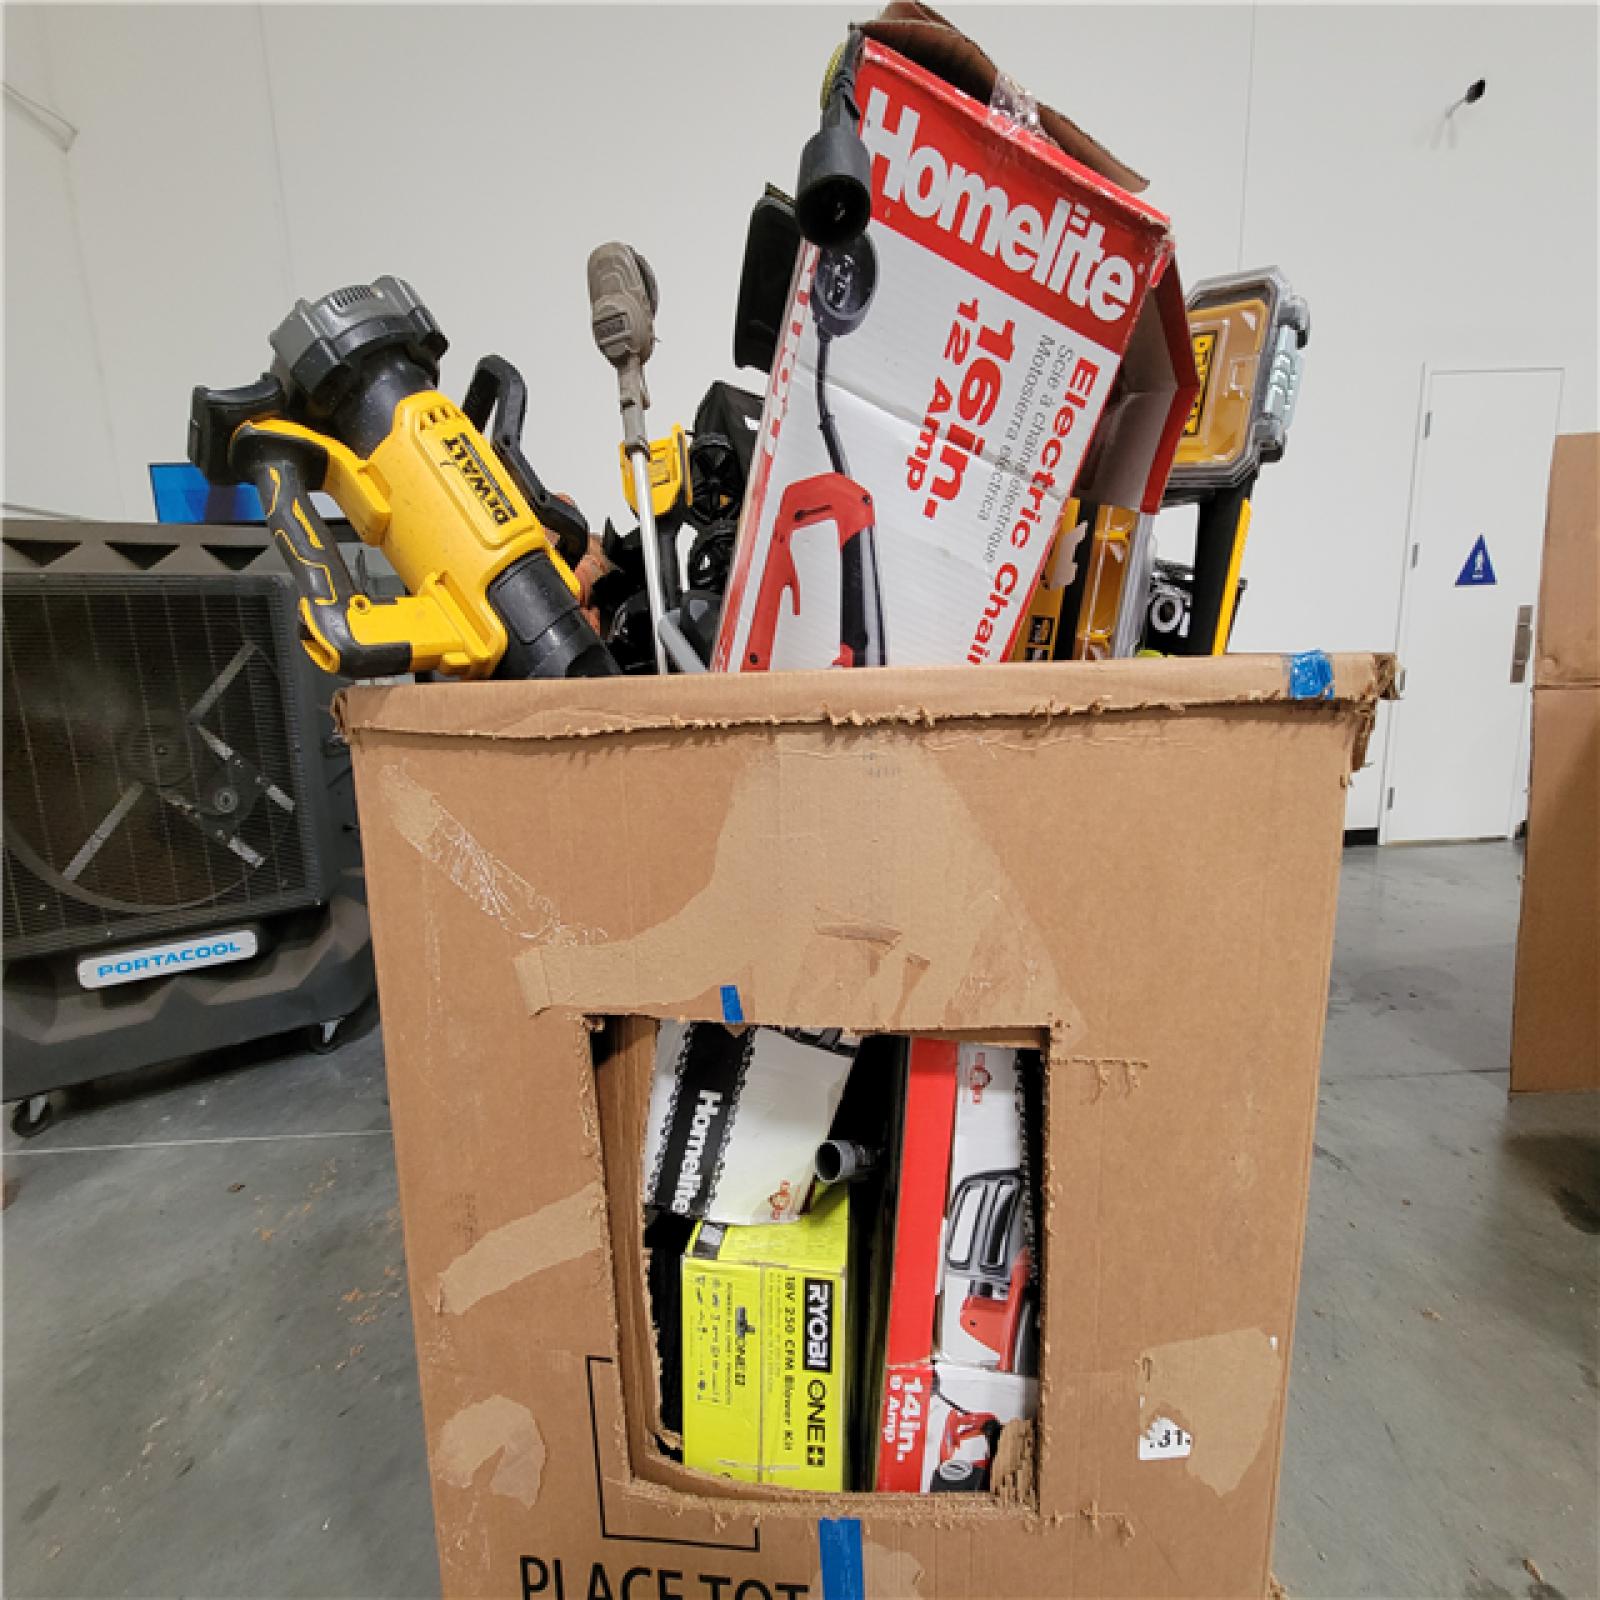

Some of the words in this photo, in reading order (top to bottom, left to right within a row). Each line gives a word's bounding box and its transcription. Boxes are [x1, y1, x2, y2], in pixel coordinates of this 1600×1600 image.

[860, 86, 1134, 321] Homelite
[942, 298, 979, 366] 12
[907, 376, 953, 491] Amp
[923, 320, 1015, 520] 16in.
[1010, 356, 1100, 548] Electric
[97, 942, 241, 977] PORTACOOL
[671, 1089, 724, 1214] Homelite
[807, 1283, 829, 1369] RYOBI
[884, 1395, 900, 1443] Amp
[520, 1555, 684, 1600] PLACE
